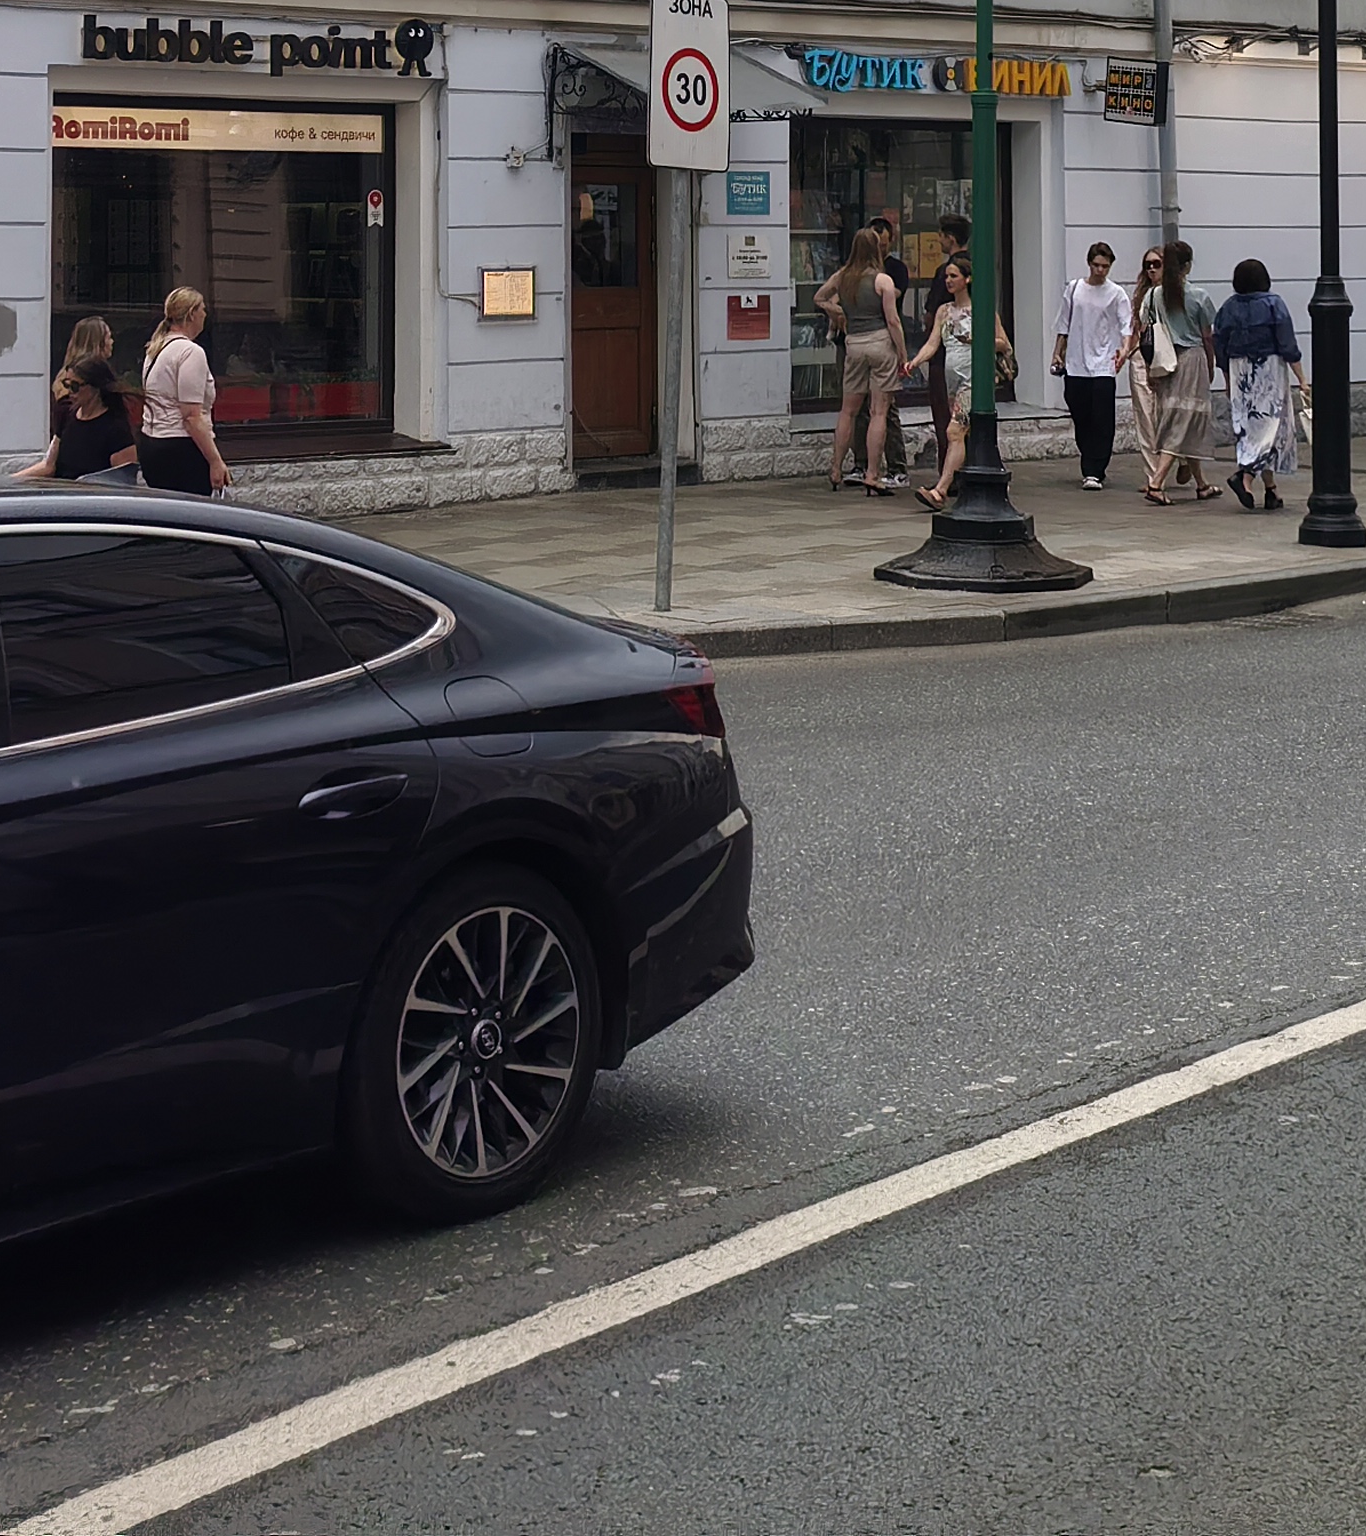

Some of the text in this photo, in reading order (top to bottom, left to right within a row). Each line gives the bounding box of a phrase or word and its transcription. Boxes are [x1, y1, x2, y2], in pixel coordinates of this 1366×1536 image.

[82, 14, 393, 77] bubble point
[1109, 72, 1142, 85] МИР
[675, 72, 707, 106] 30
[1108, 95, 1153, 110] КИНО
[52, 115, 189, 141] RomiRomi
[275, 127, 375, 142] кофе & сендвичи
